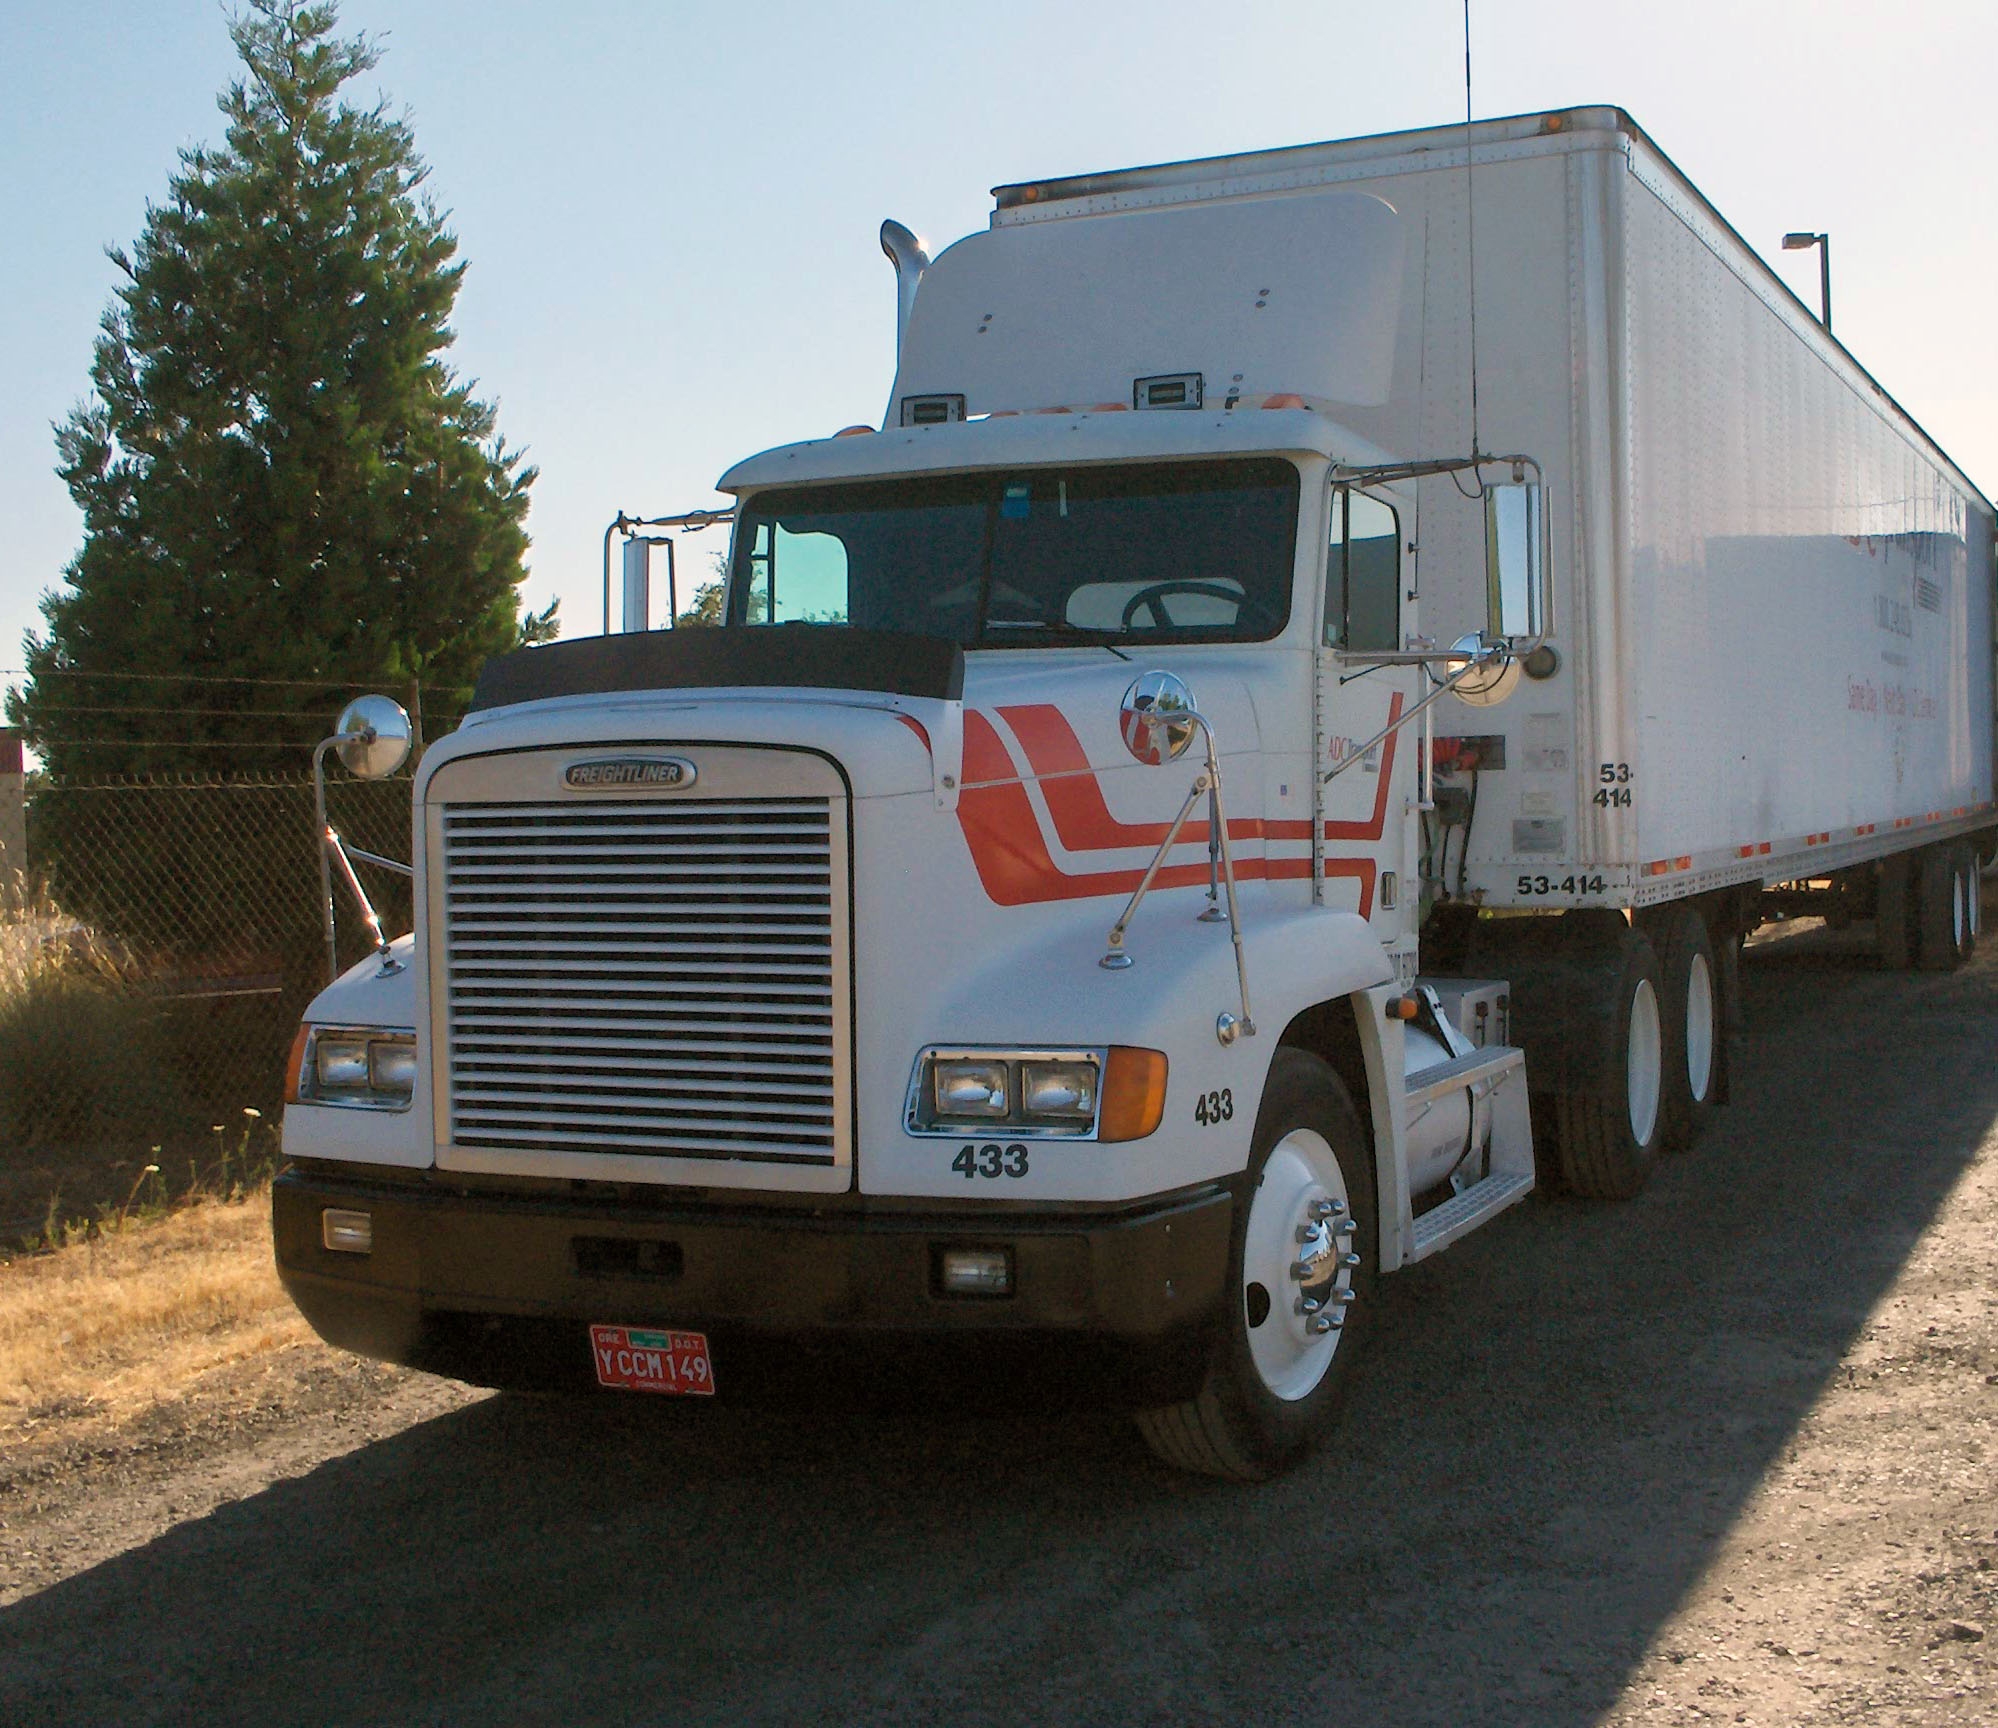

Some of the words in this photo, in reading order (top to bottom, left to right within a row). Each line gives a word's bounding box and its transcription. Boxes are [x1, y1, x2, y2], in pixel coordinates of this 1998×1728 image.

[571, 764, 678, 783] FREIGHTLINER
[1593, 788, 1631, 808] 414
[1517, 875, 1603, 896] 53-414
[1195, 1088, 1233, 1126] 433
[952, 1144, 1029, 1178] 433
[600, 1349, 708, 1382] YCCM149
